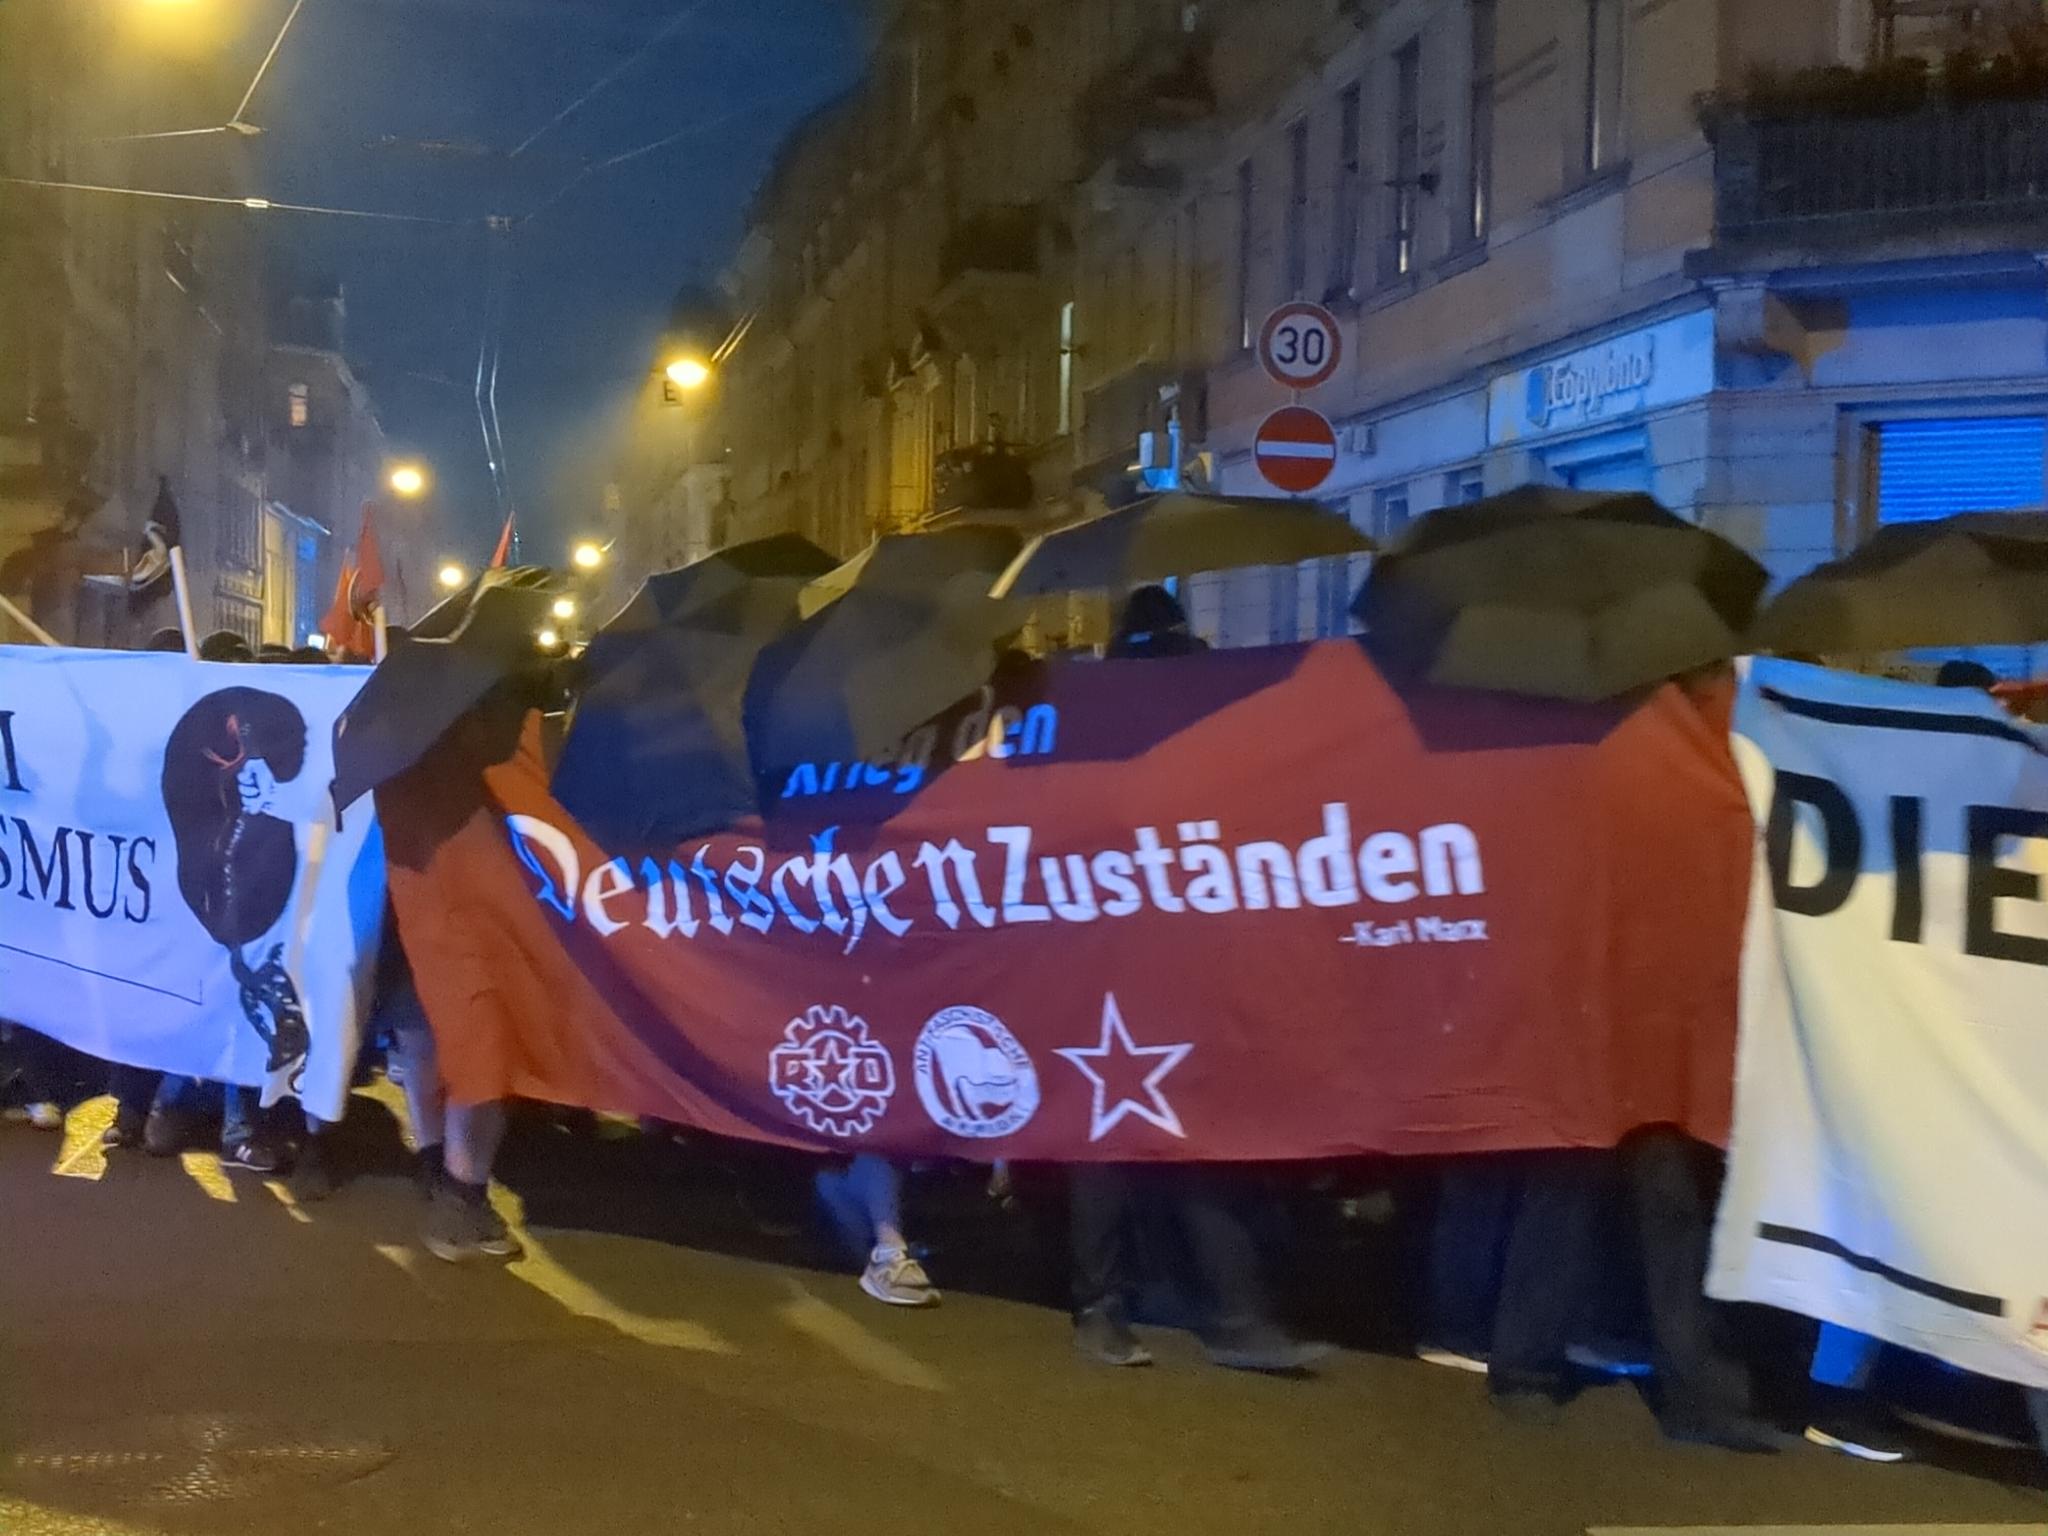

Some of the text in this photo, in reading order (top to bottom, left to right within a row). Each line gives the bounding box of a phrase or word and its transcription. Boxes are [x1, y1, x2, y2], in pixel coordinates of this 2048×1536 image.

[1276, 326, 1325, 366] 30
[505, 802, 1485, 956] Deutschen Zuständen
[1766, 769, 2048, 966] DIE
